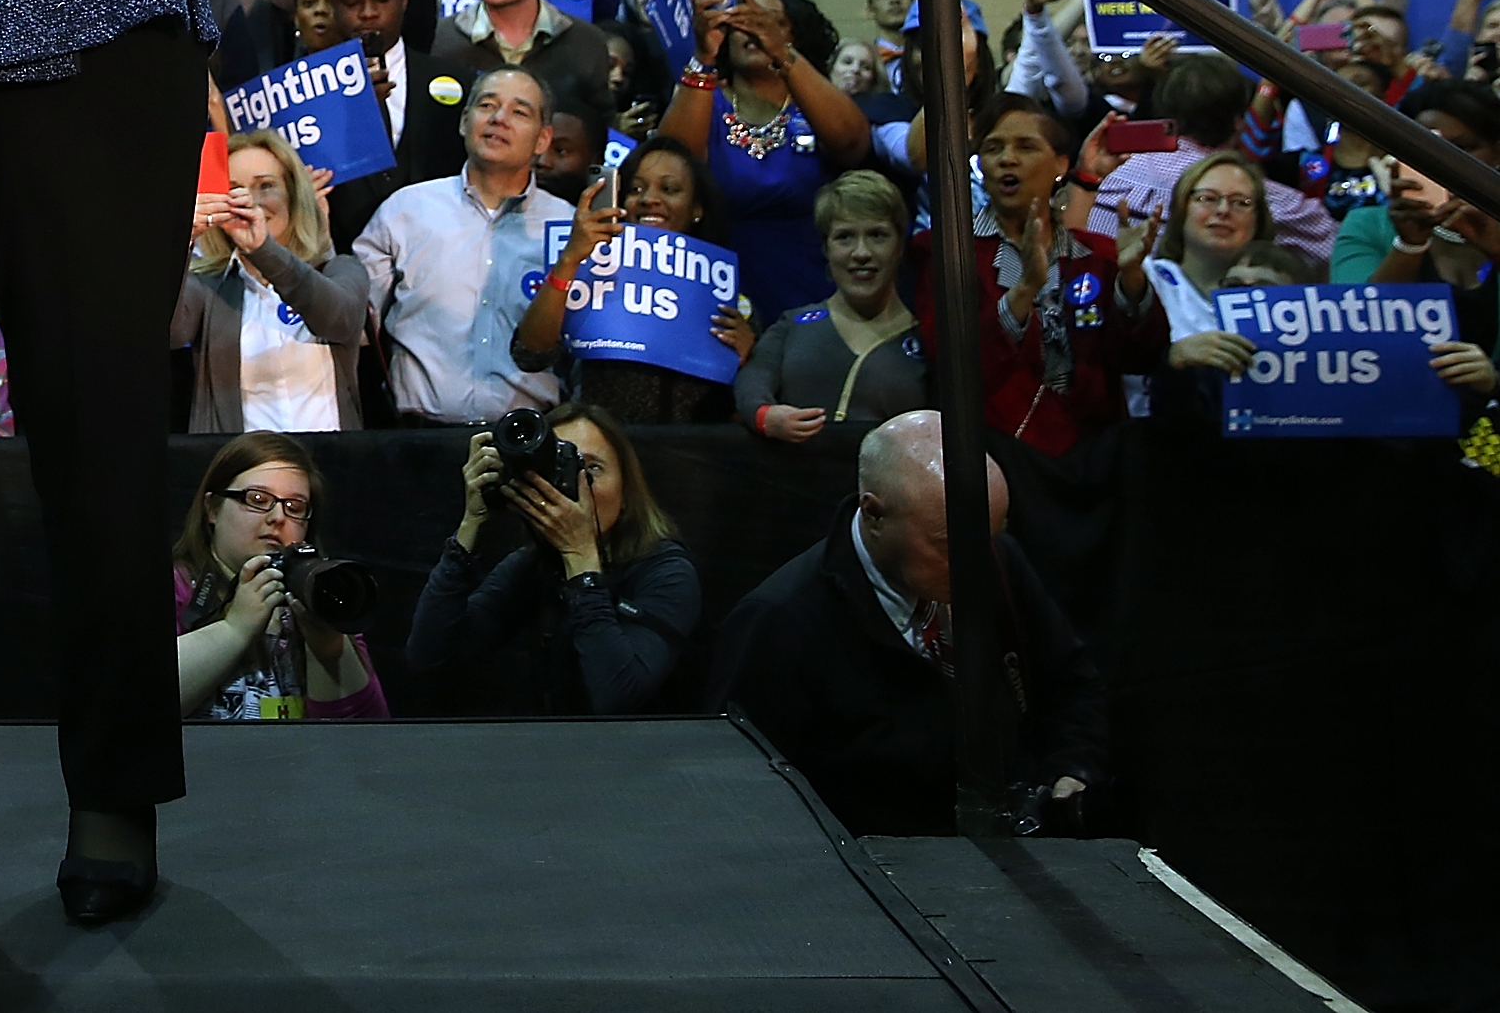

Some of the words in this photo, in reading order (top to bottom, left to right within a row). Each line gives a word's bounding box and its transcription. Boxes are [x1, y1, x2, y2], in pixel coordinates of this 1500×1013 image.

[225, 52, 367, 133] Fighting
[278, 112, 323, 153] us
[548, 225, 736, 302] Fghting
[565, 279, 615, 311] or
[623, 282, 680, 320] us
[1216, 285, 1454, 346] Fighting
[1229, 349, 1307, 385] or
[1316, 349, 1382, 385] us
